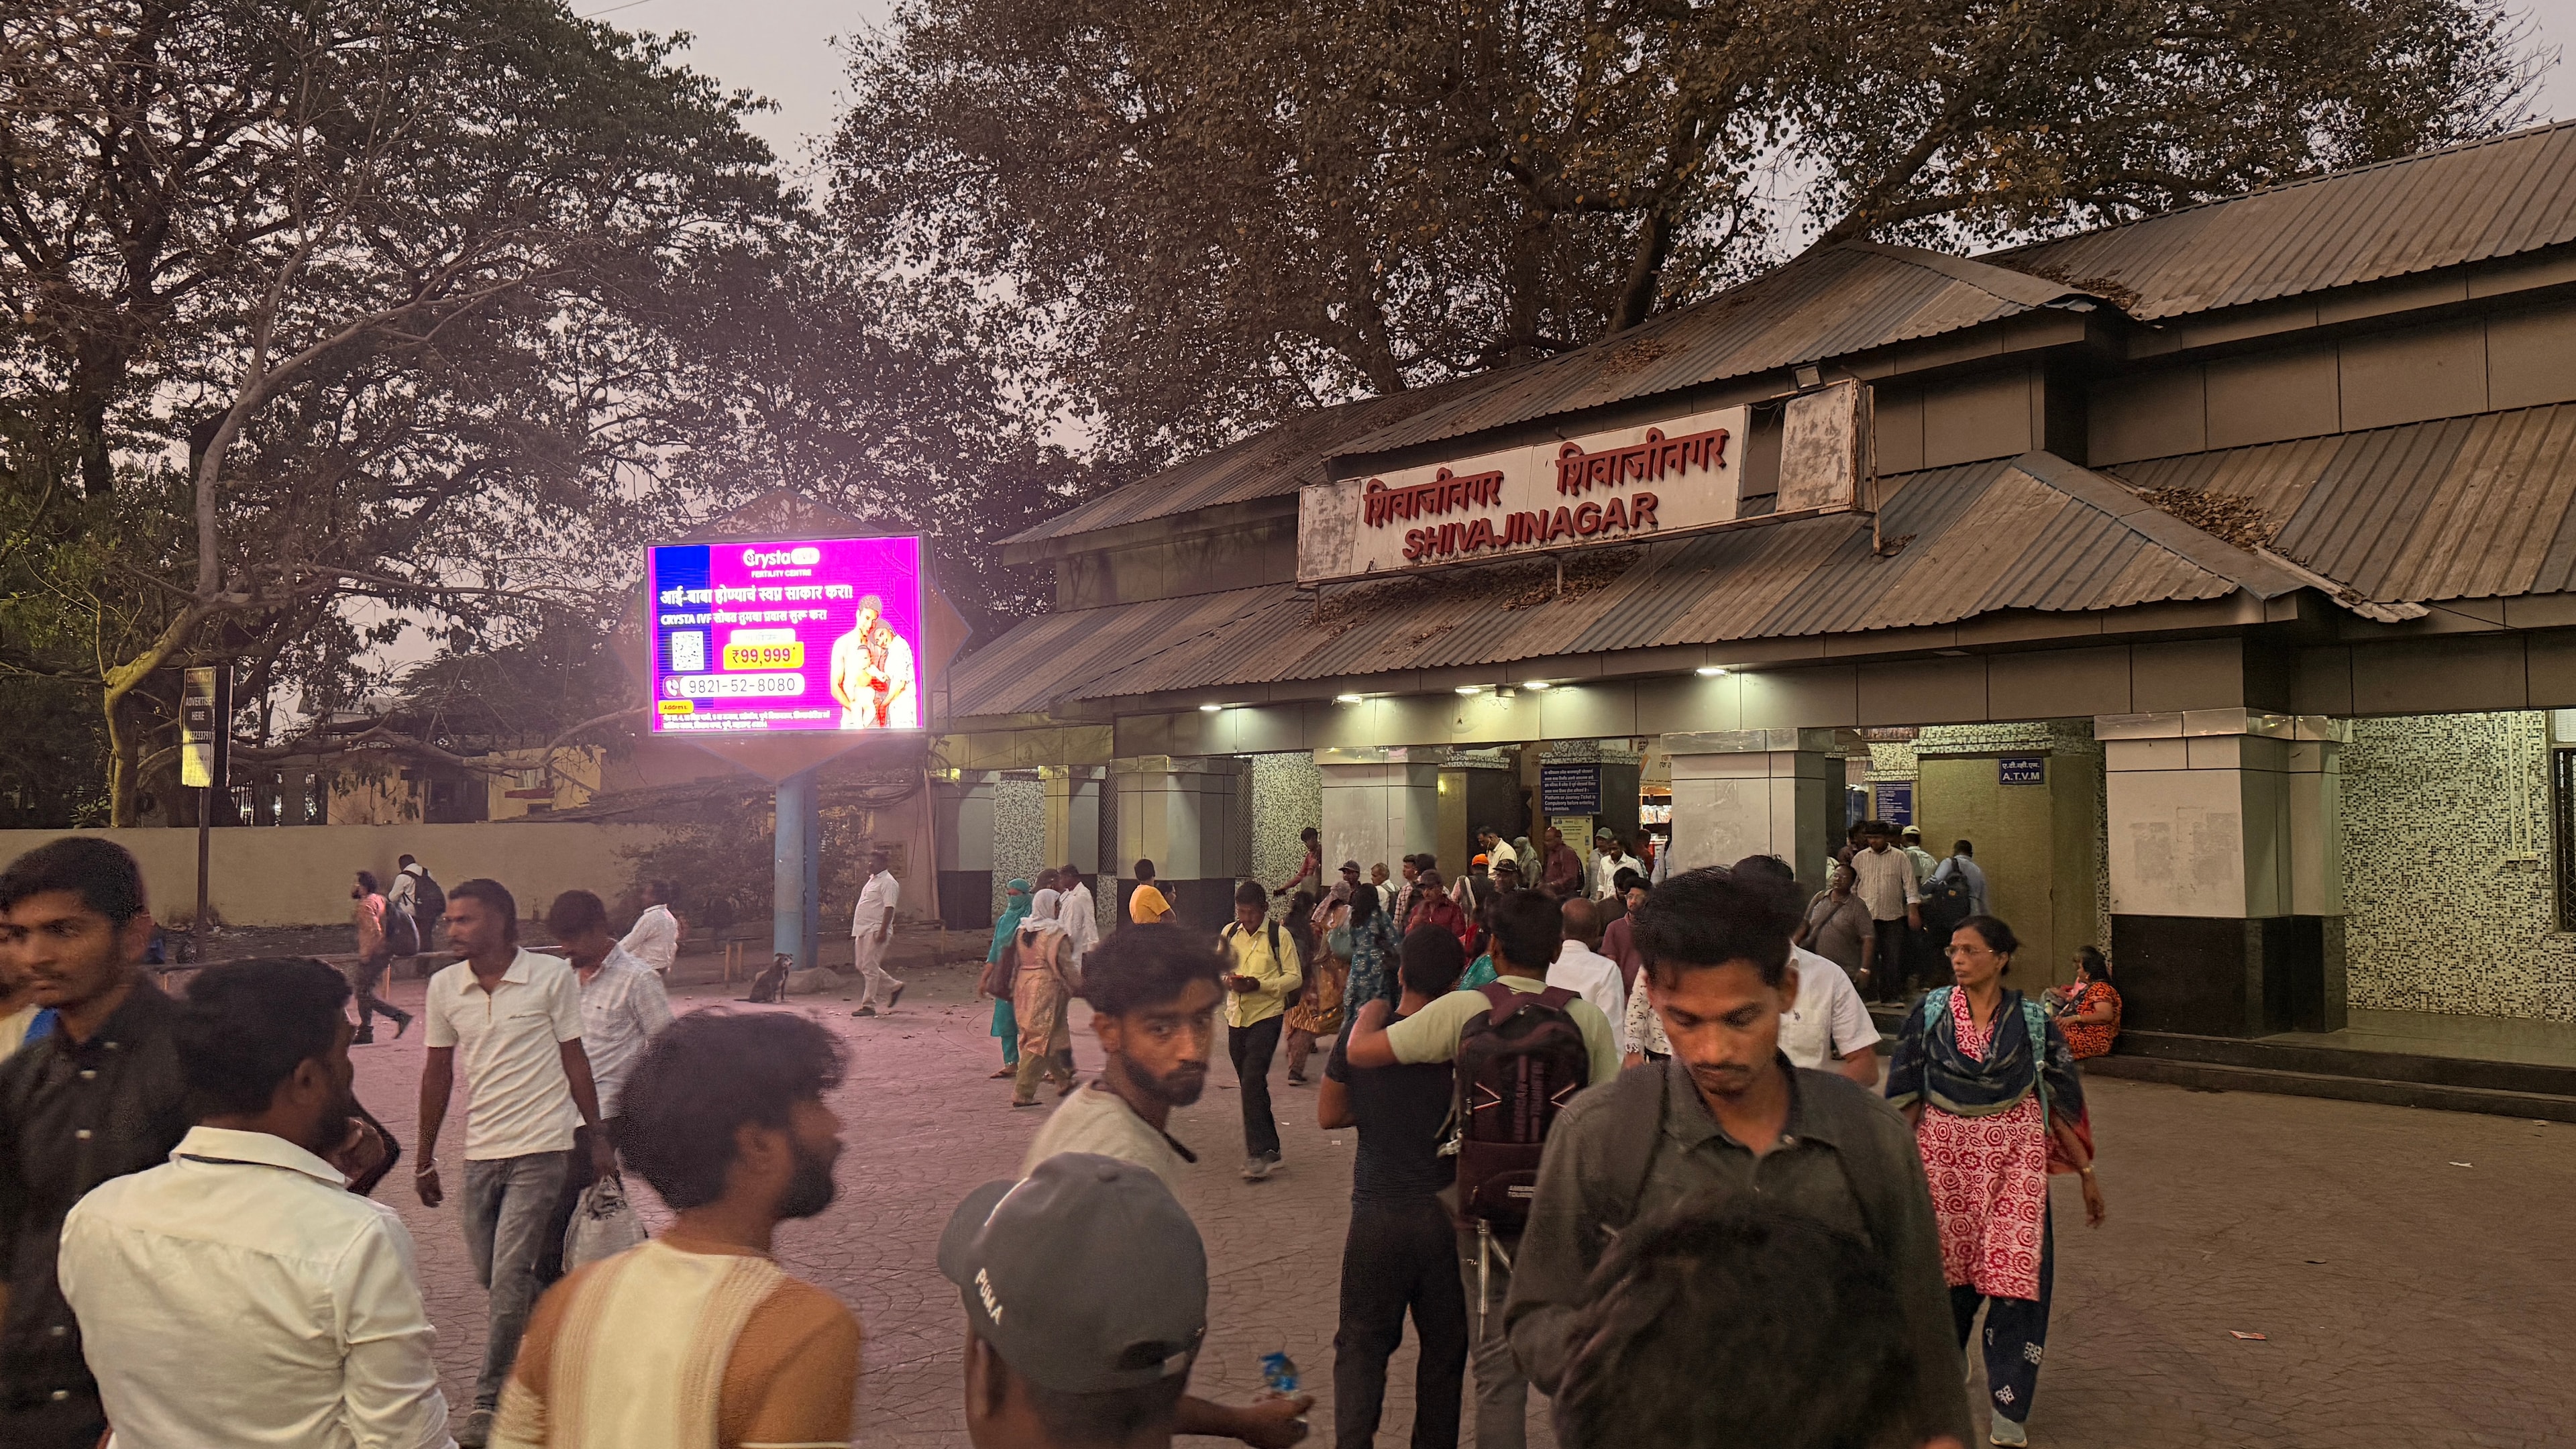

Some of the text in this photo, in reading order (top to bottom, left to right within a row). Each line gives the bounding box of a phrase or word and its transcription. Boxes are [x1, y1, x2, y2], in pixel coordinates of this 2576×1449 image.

[1362, 427, 1730, 529] शिवाजीनगर शिवाजीनगर
[1402, 492, 1659, 559] SHIVAJINAGAR
[743, 549, 792, 570] Crysta
[751, 570, 784, 578] FERTILITY
[659, 585, 713, 607] आई-बाबा
[784, 585, 823, 600] साकार
[660, 613, 696, 625] CRYSTA
[696, 613, 712, 624] IVF
[187, 672, 213, 683] CONTACT
[689, 678, 796, 694] 9821-52-8080
[185, 696, 213, 706] ADVERTISE
[191, 711, 205, 720] HERE
[2002, 771, 2040, 781] A.T.V.M
[975, 1267, 1003, 1326] PUMA
